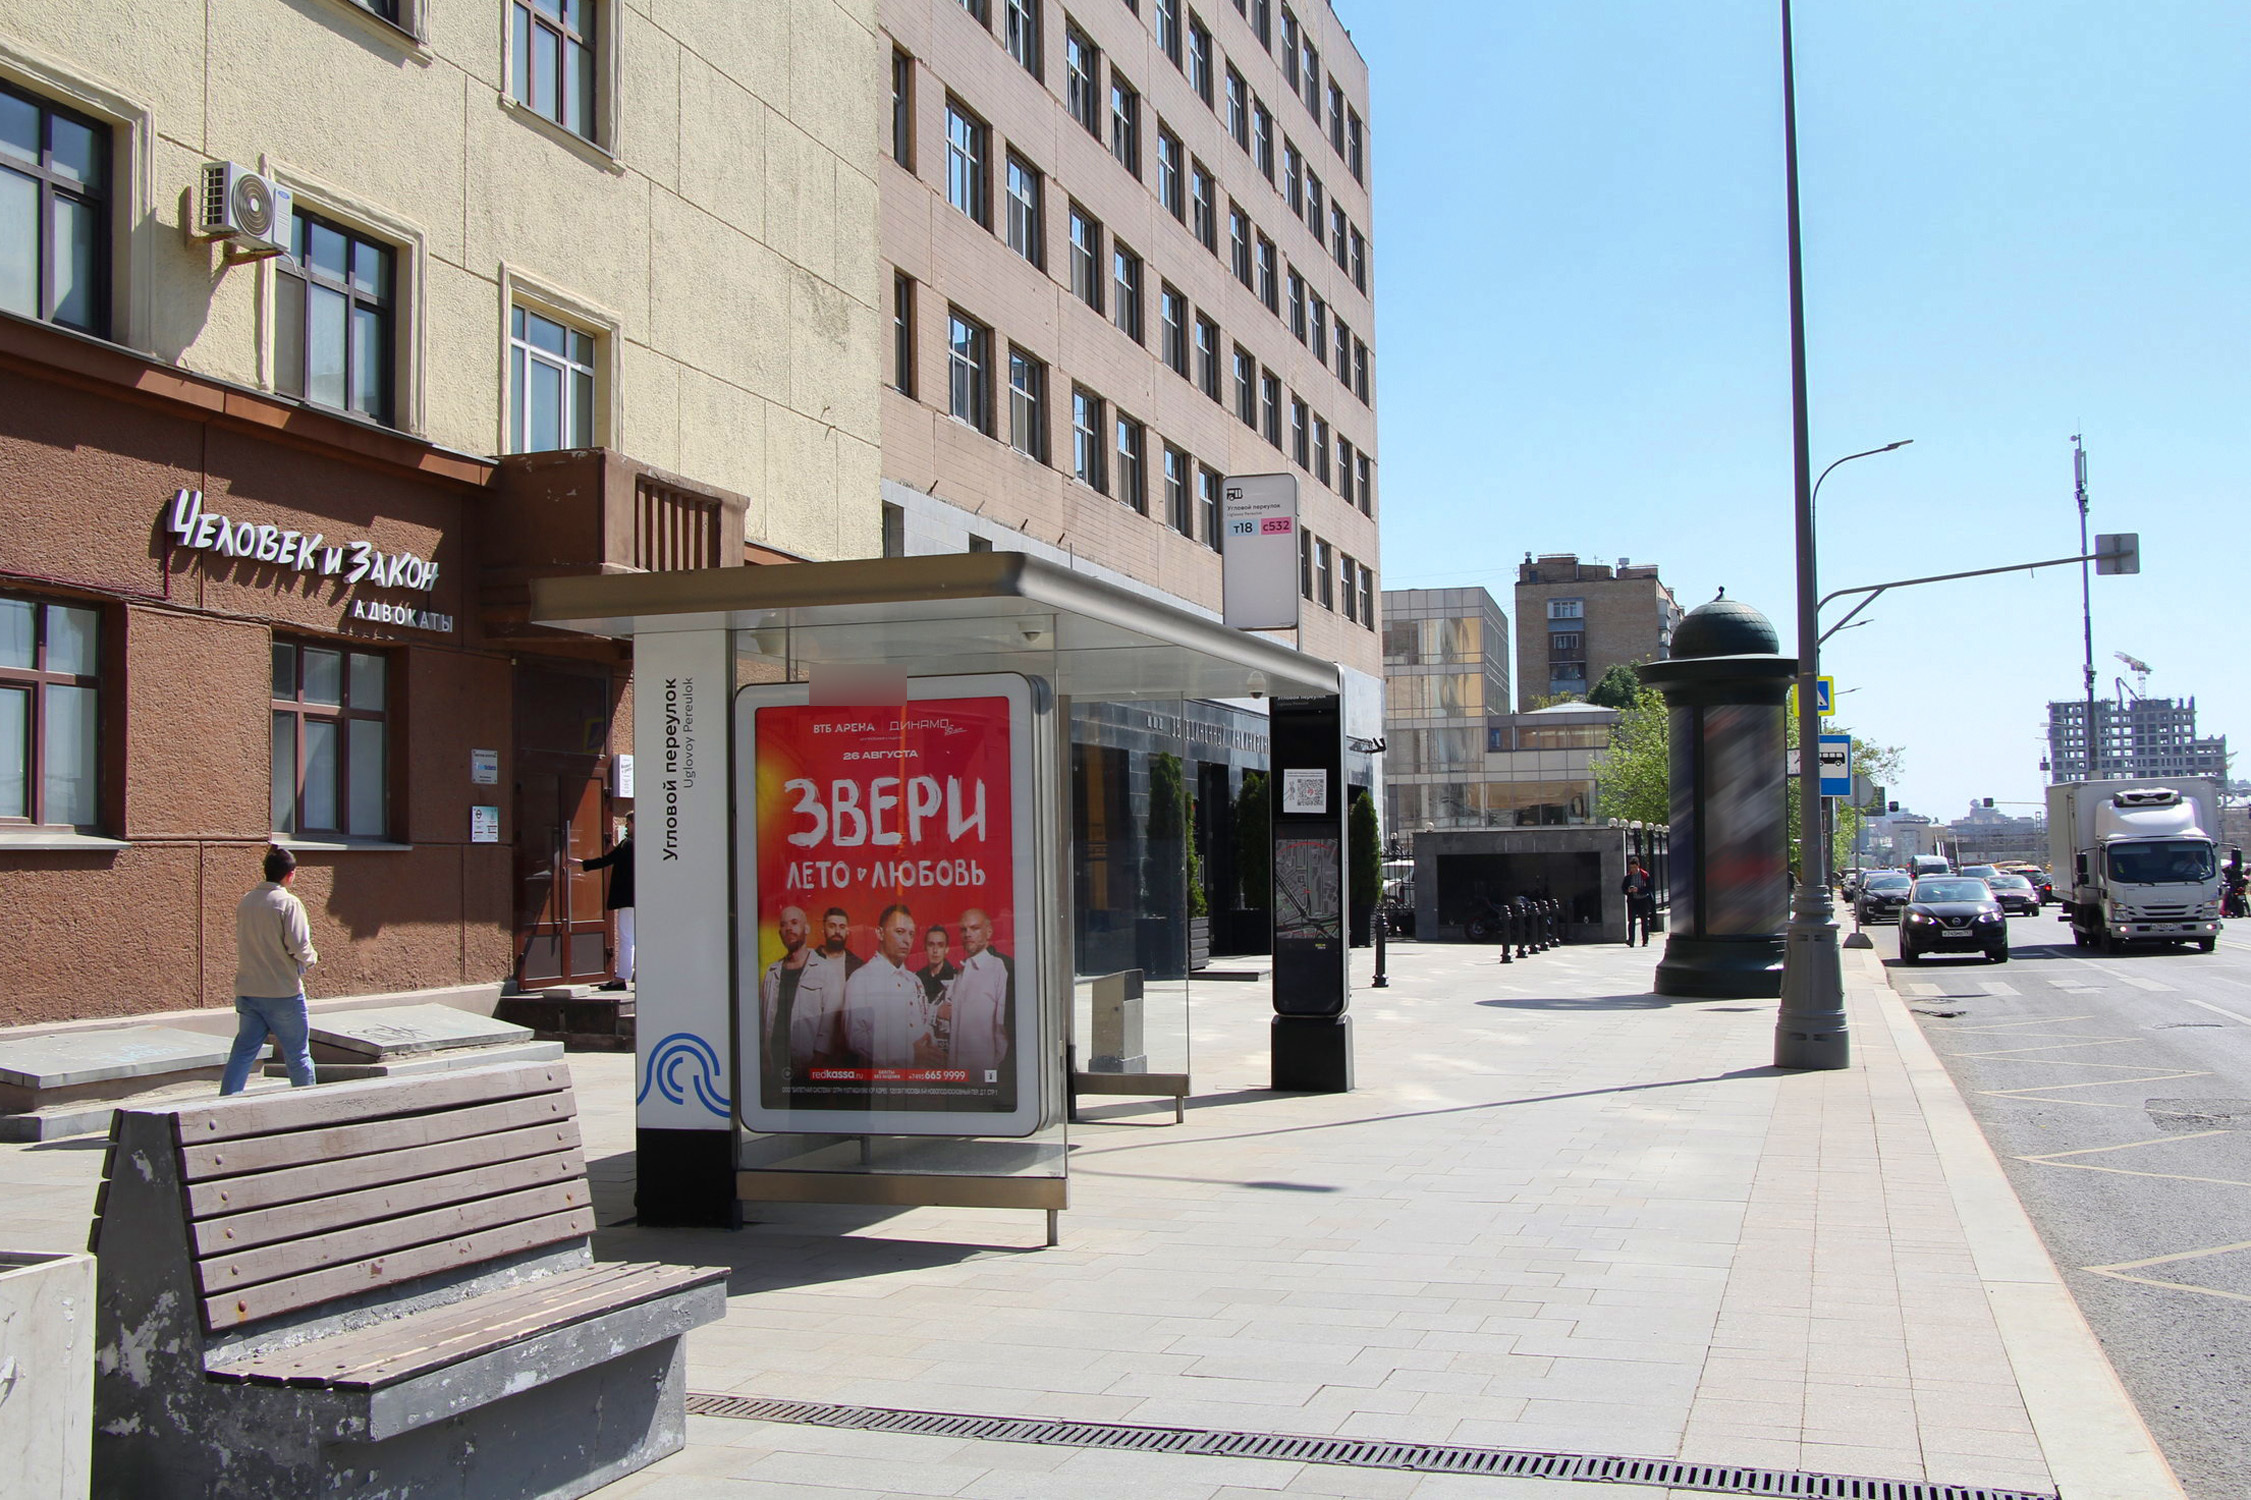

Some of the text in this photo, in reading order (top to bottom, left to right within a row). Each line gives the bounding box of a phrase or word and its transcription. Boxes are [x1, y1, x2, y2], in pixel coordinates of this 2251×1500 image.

[354, 599, 453, 633] АДВОКАТЫ
[683, 677, 696, 788] Uglovoy Pereulok
[813, 722, 875, 734] ВТБ АРЕНА
[889, 718, 949, 731] ДИНАМО
[662, 677, 680, 861] Угловой переулок
[843, 749, 918, 761] 26 АВГУСТА
[784, 774, 986, 848] ЗВЕРИ
[786, 858, 986, 890] ЛЕТО ЛЮБОВЬ
[924, 1070, 942, 1080] 665
[944, 1070, 966, 1080] 9999
